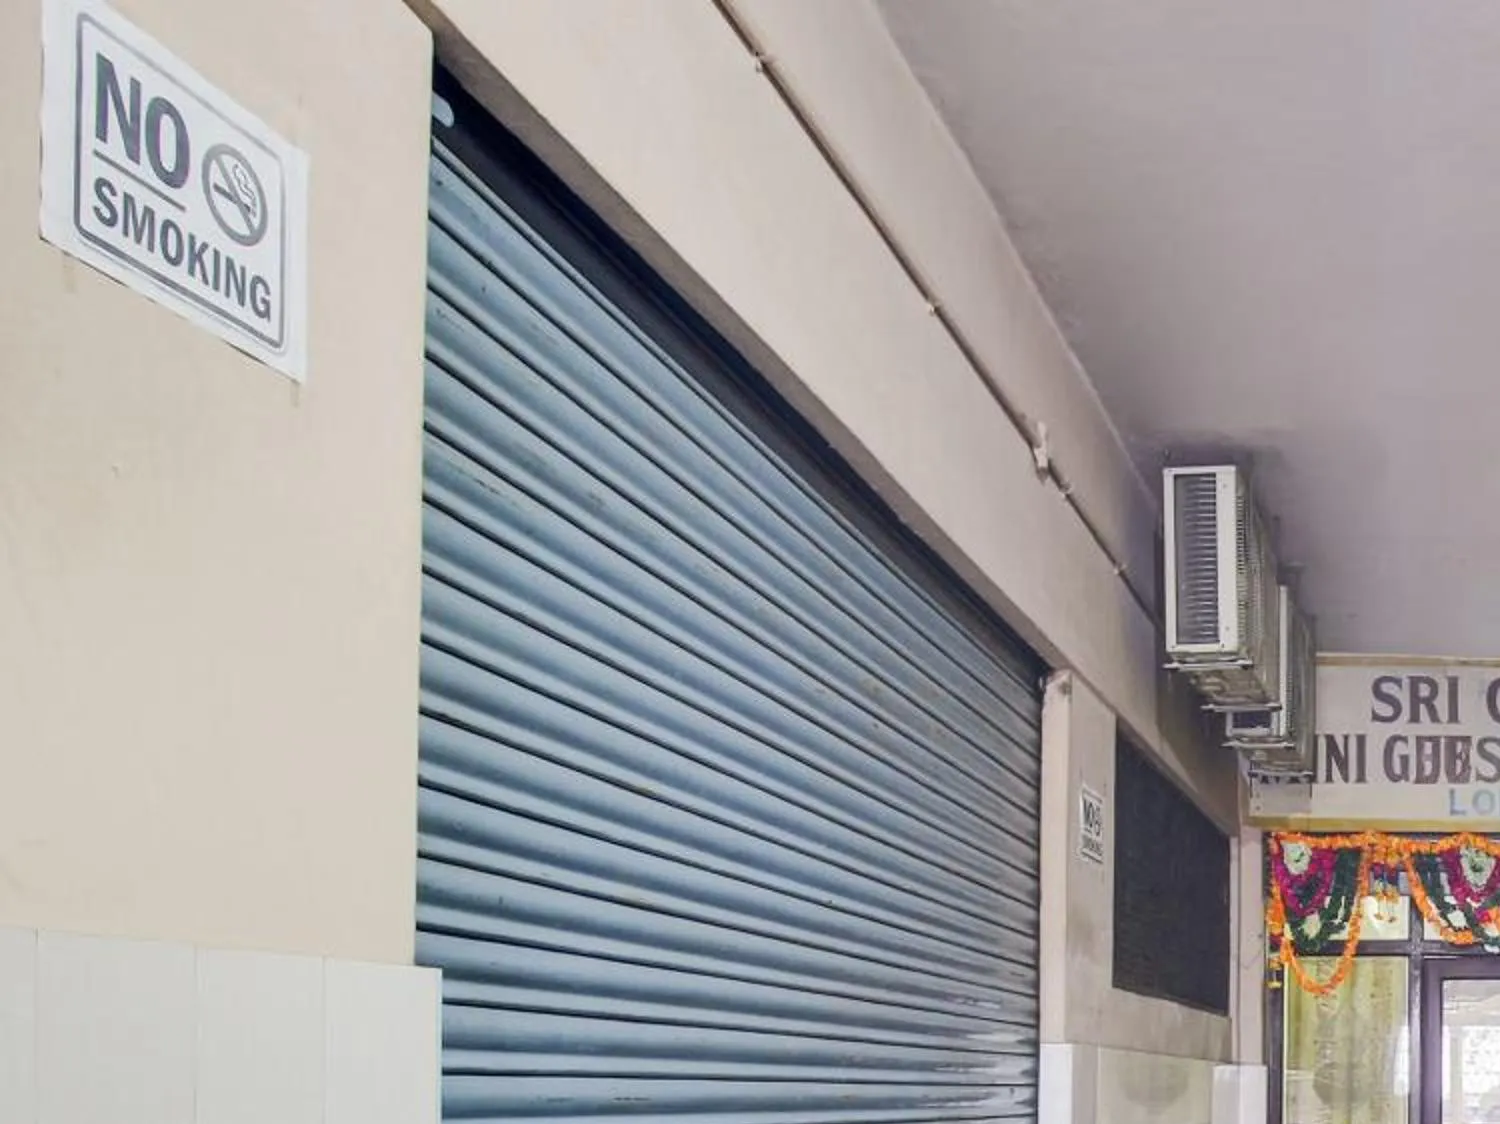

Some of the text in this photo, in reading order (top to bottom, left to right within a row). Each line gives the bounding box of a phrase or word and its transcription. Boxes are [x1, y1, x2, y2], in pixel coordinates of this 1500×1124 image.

[94, 51, 191, 190] NO
[92, 176, 272, 323] SMOKING
[1371, 675, 1461, 724] SRI
